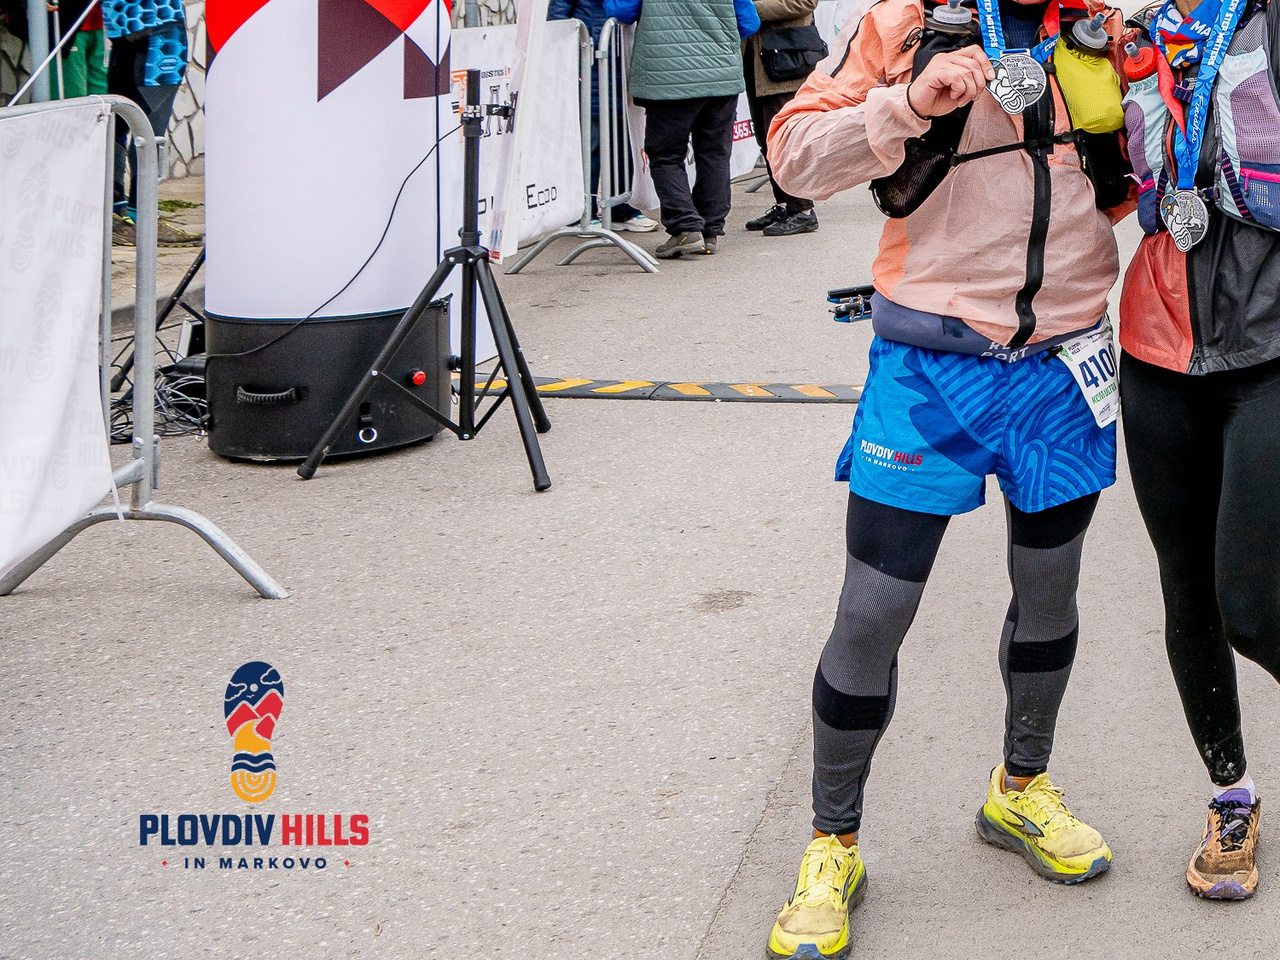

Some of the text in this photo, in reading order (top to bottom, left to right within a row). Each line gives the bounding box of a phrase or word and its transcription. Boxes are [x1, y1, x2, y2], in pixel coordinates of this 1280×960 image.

[1220, 11, 1235, 32] STEP
[860, 439, 923, 466] PLOVDIV HILLS
